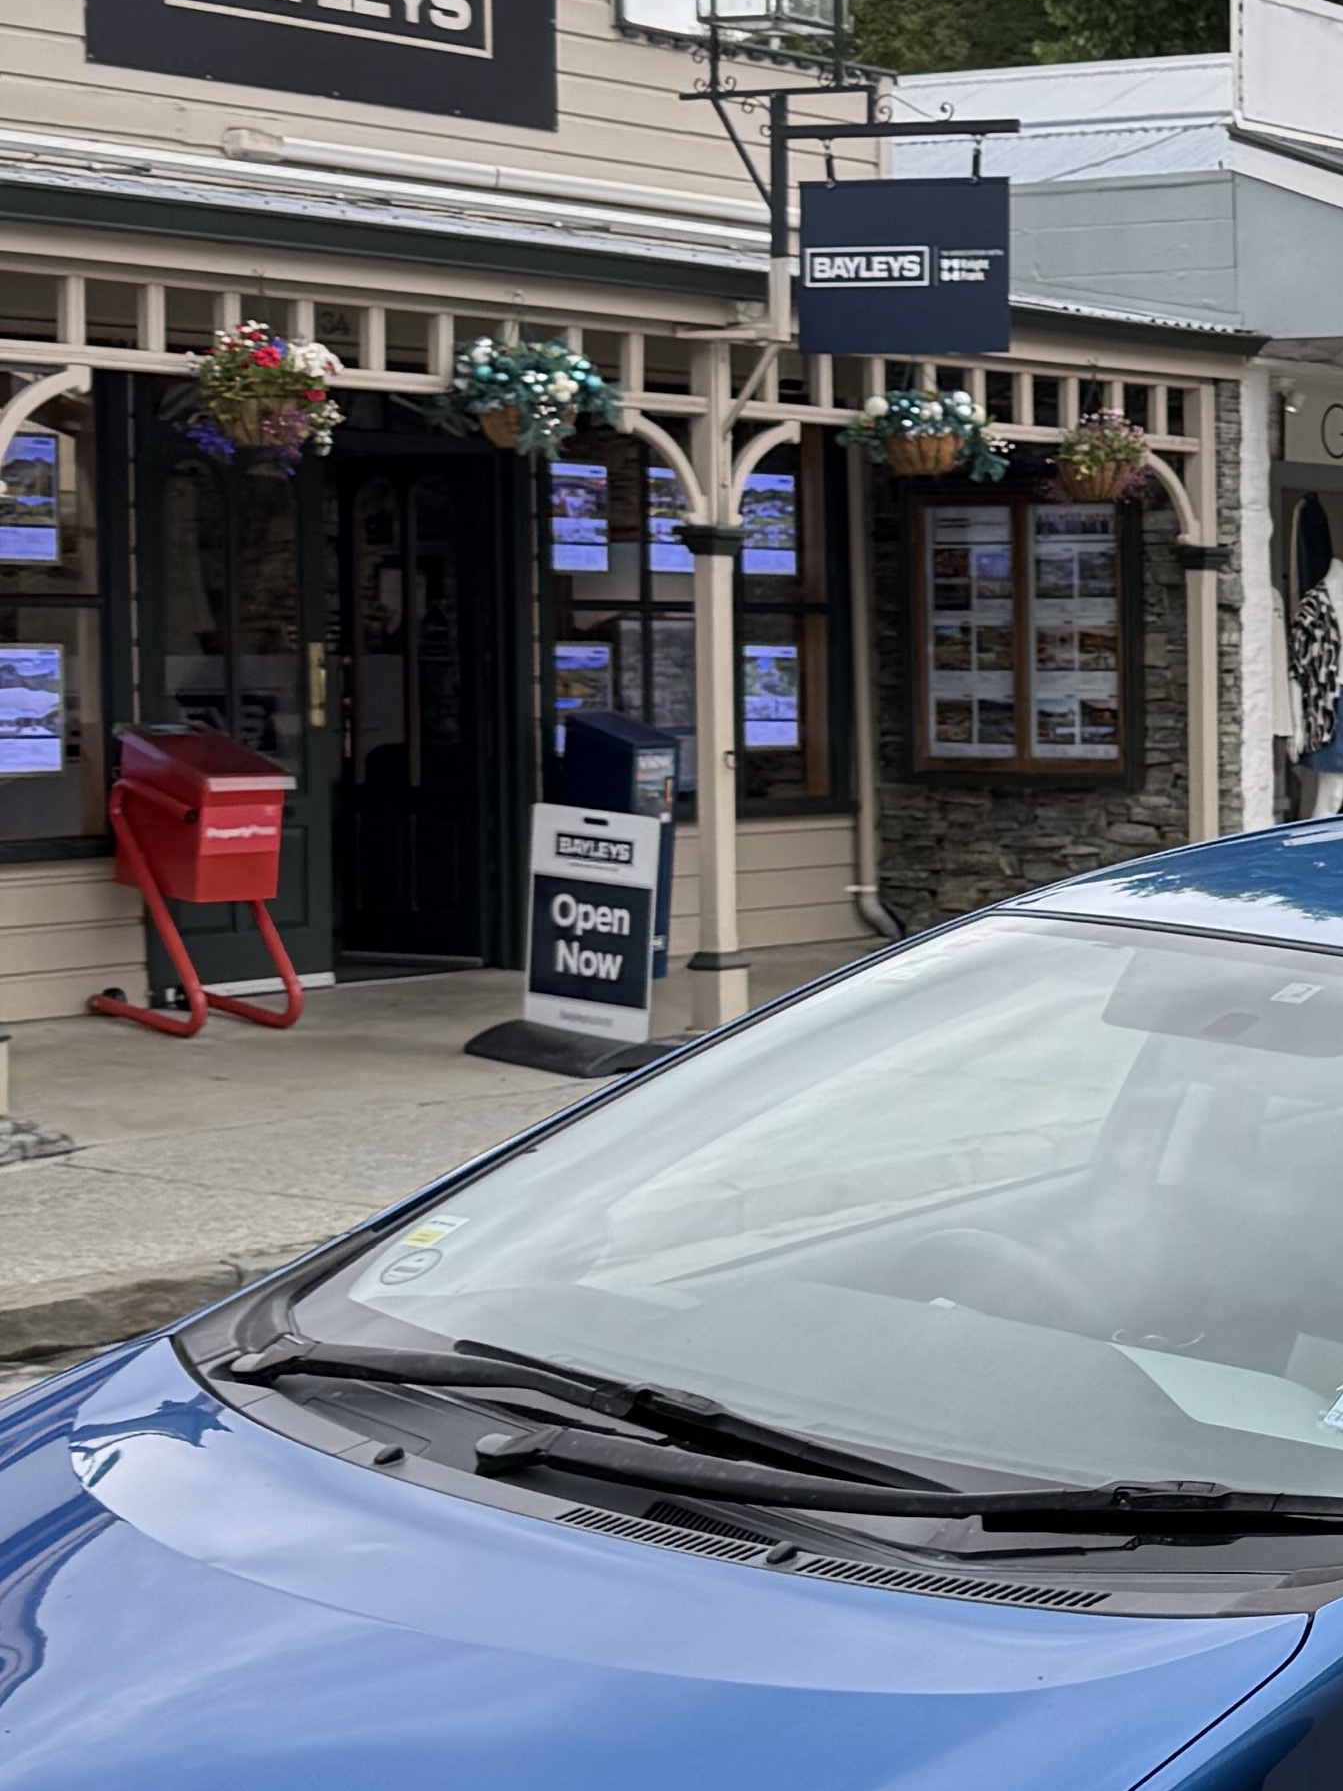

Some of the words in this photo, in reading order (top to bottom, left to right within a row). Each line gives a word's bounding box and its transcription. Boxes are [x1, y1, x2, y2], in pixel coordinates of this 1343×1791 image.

[812, 254, 921, 279] BAYLEYS
[559, 835, 631, 862] BAYLEYS
[552, 893, 631, 936] Open
[555, 939, 623, 982] Now
